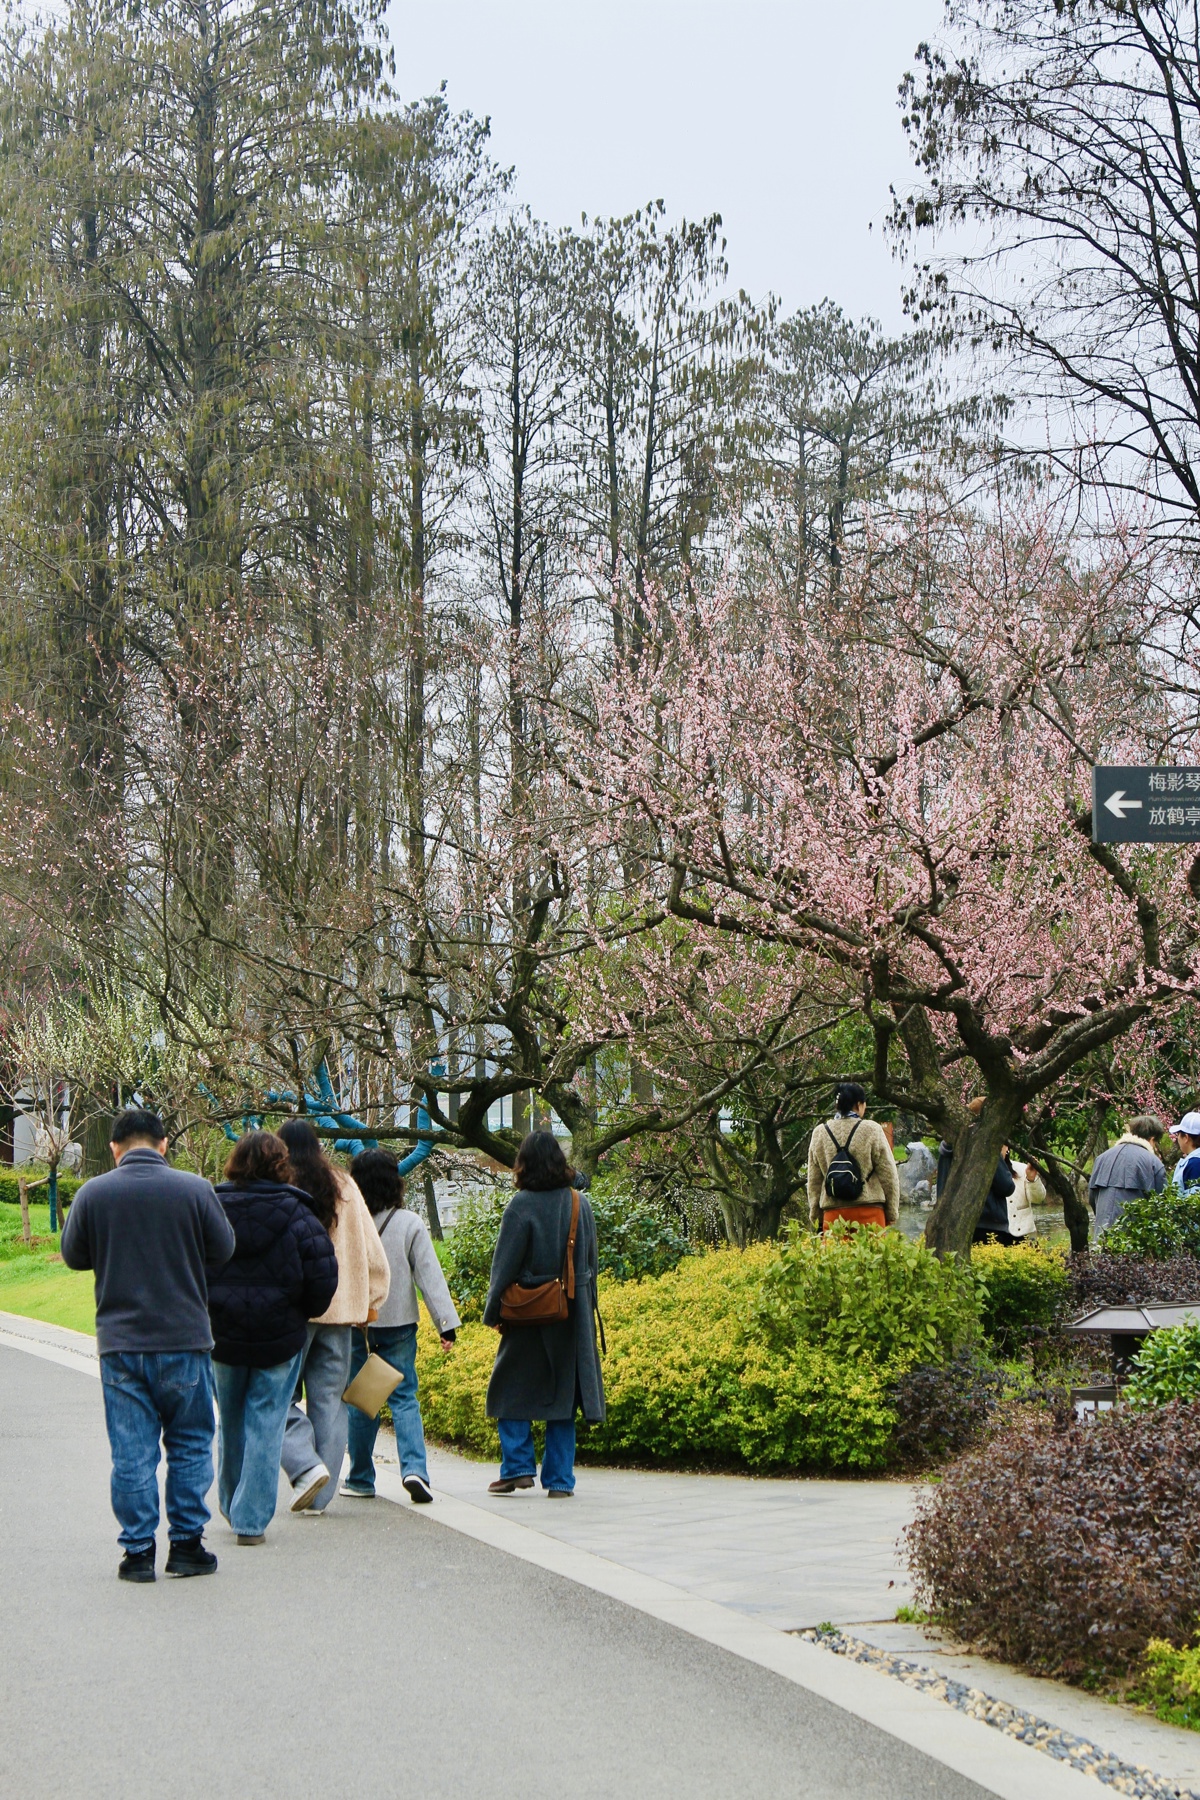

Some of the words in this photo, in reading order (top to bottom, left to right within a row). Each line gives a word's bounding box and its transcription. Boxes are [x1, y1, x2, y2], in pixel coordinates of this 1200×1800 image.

[1148, 772, 1200, 791] 梅影琴
[1148, 805, 1200, 826] 放鹤亭
